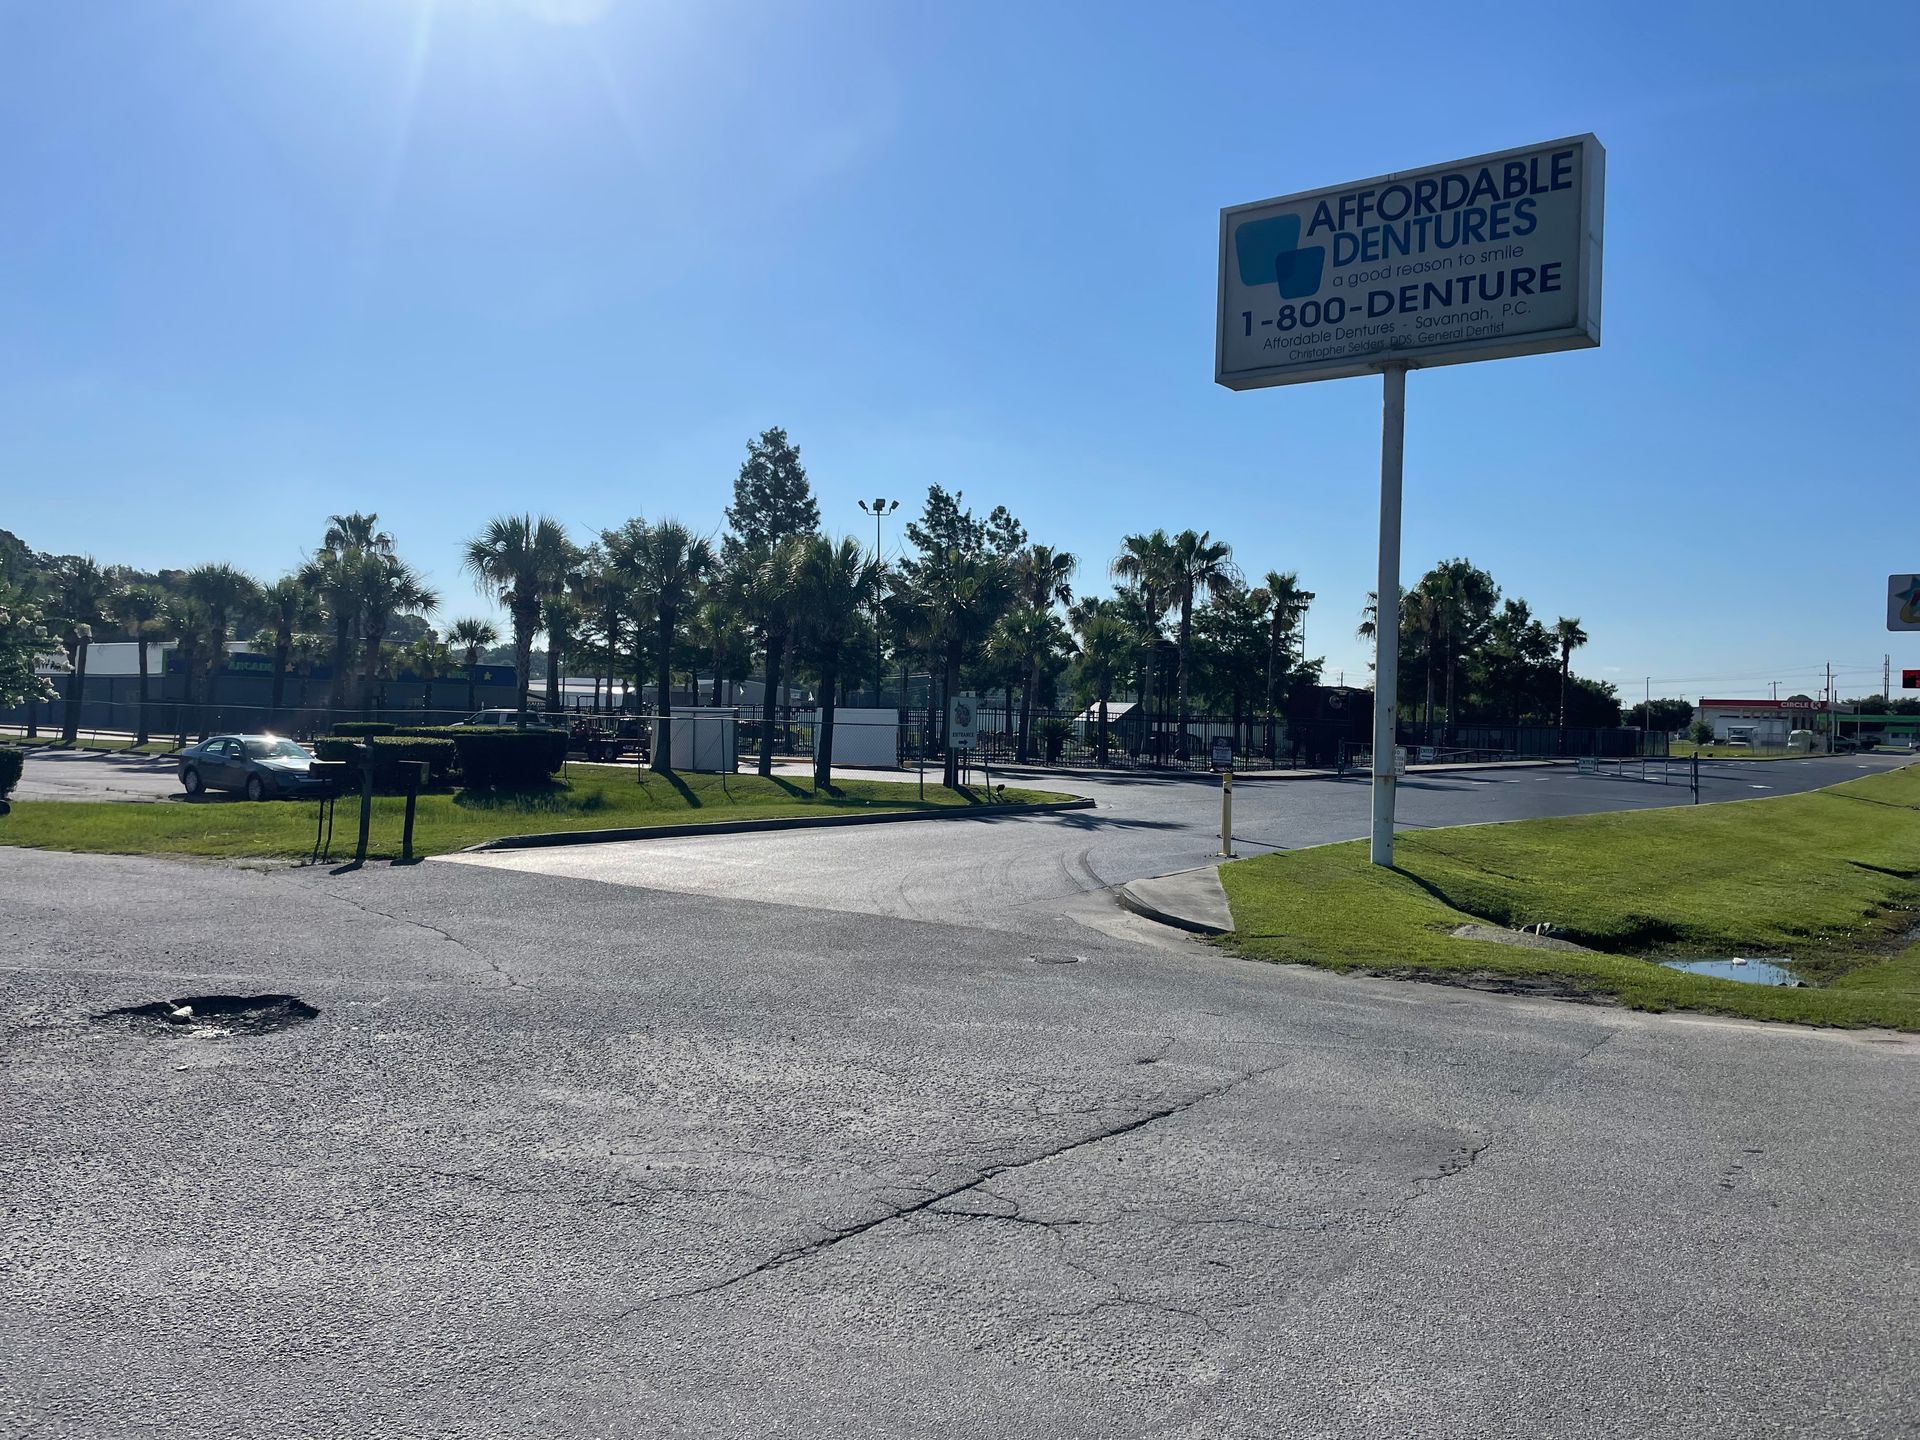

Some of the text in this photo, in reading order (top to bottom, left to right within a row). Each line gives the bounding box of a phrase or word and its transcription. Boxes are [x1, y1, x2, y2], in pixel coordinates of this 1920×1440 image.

[1306, 151, 1573, 236] AFFORDABLE
[1333, 198, 1537, 267] DENTURES
[1333, 245, 1524, 287] a good reason to smile
[1242, 262, 1563, 336] 1-800-DENTURE
[1263, 328, 1331, 350] Affordable
[1335, 322, 1395, 340] Dentures
[1502, 301, 1531, 317] P.C.
[1289, 344, 1345, 361] Christopher
[1418, 328, 1463, 343] General
[1466, 322, 1504, 337] Dentist
[1810, 701, 1821, 710] K
